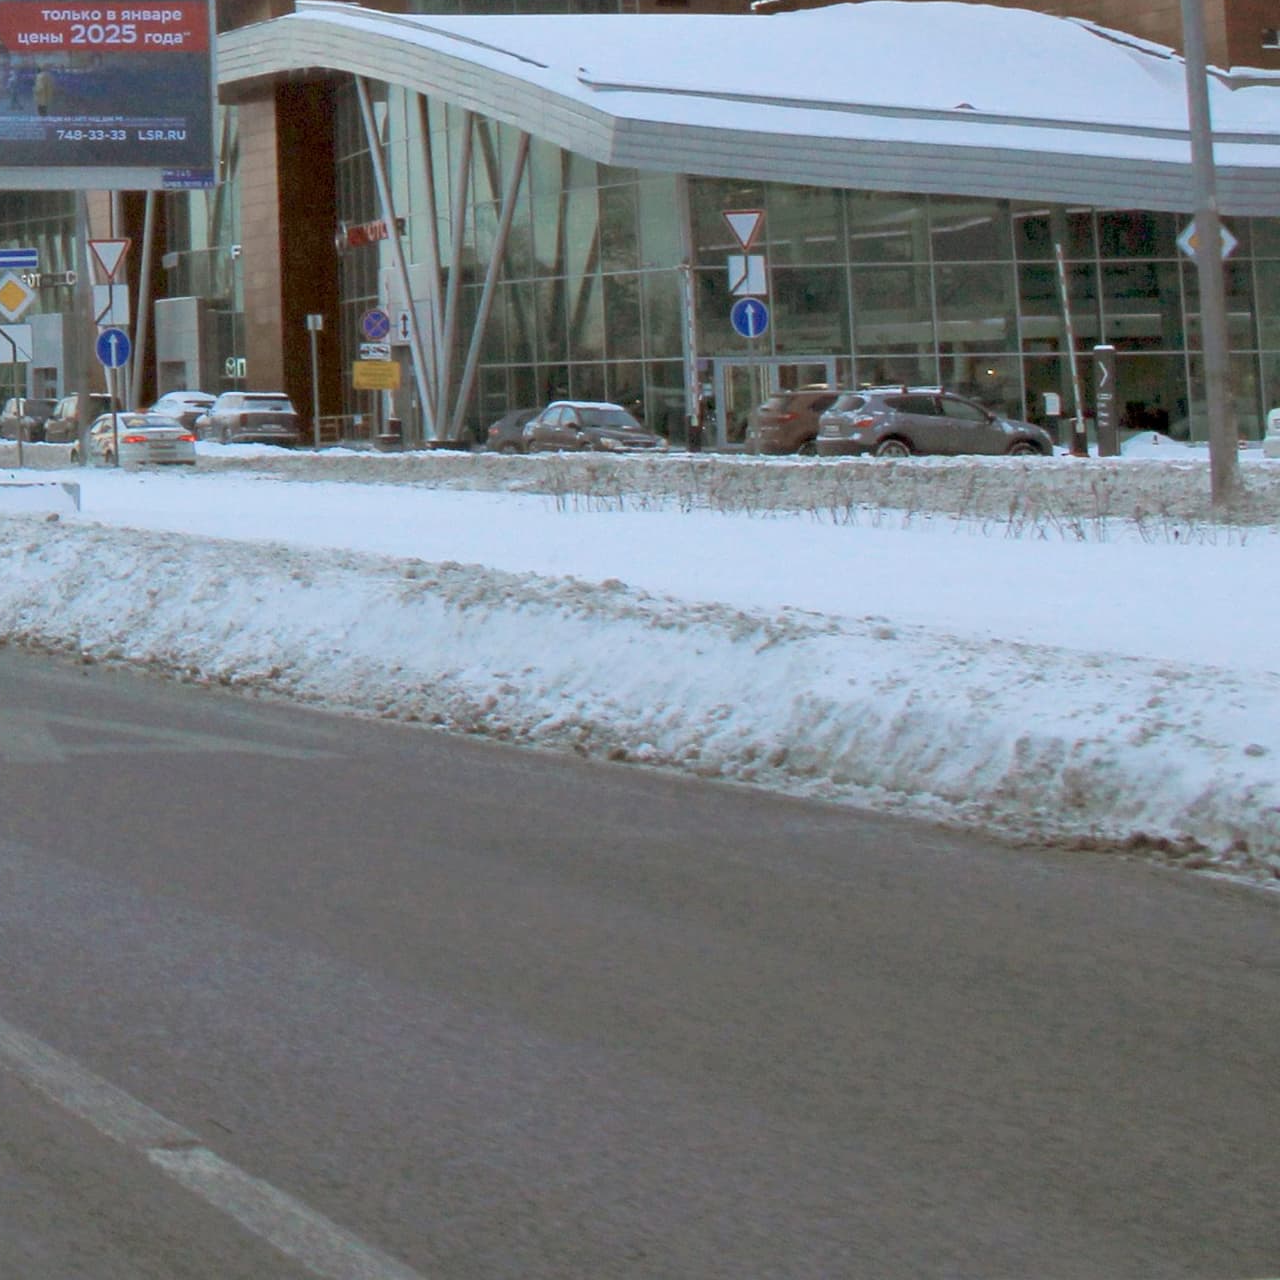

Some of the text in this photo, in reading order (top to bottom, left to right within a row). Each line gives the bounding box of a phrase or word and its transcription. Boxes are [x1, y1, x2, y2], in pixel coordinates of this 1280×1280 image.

[41, 10, 182, 24] только в январе
[18, 32, 64, 46] цены
[70, 24, 137, 44] 2025
[56, 129, 186, 141] 748-33-33 LSR.RU
